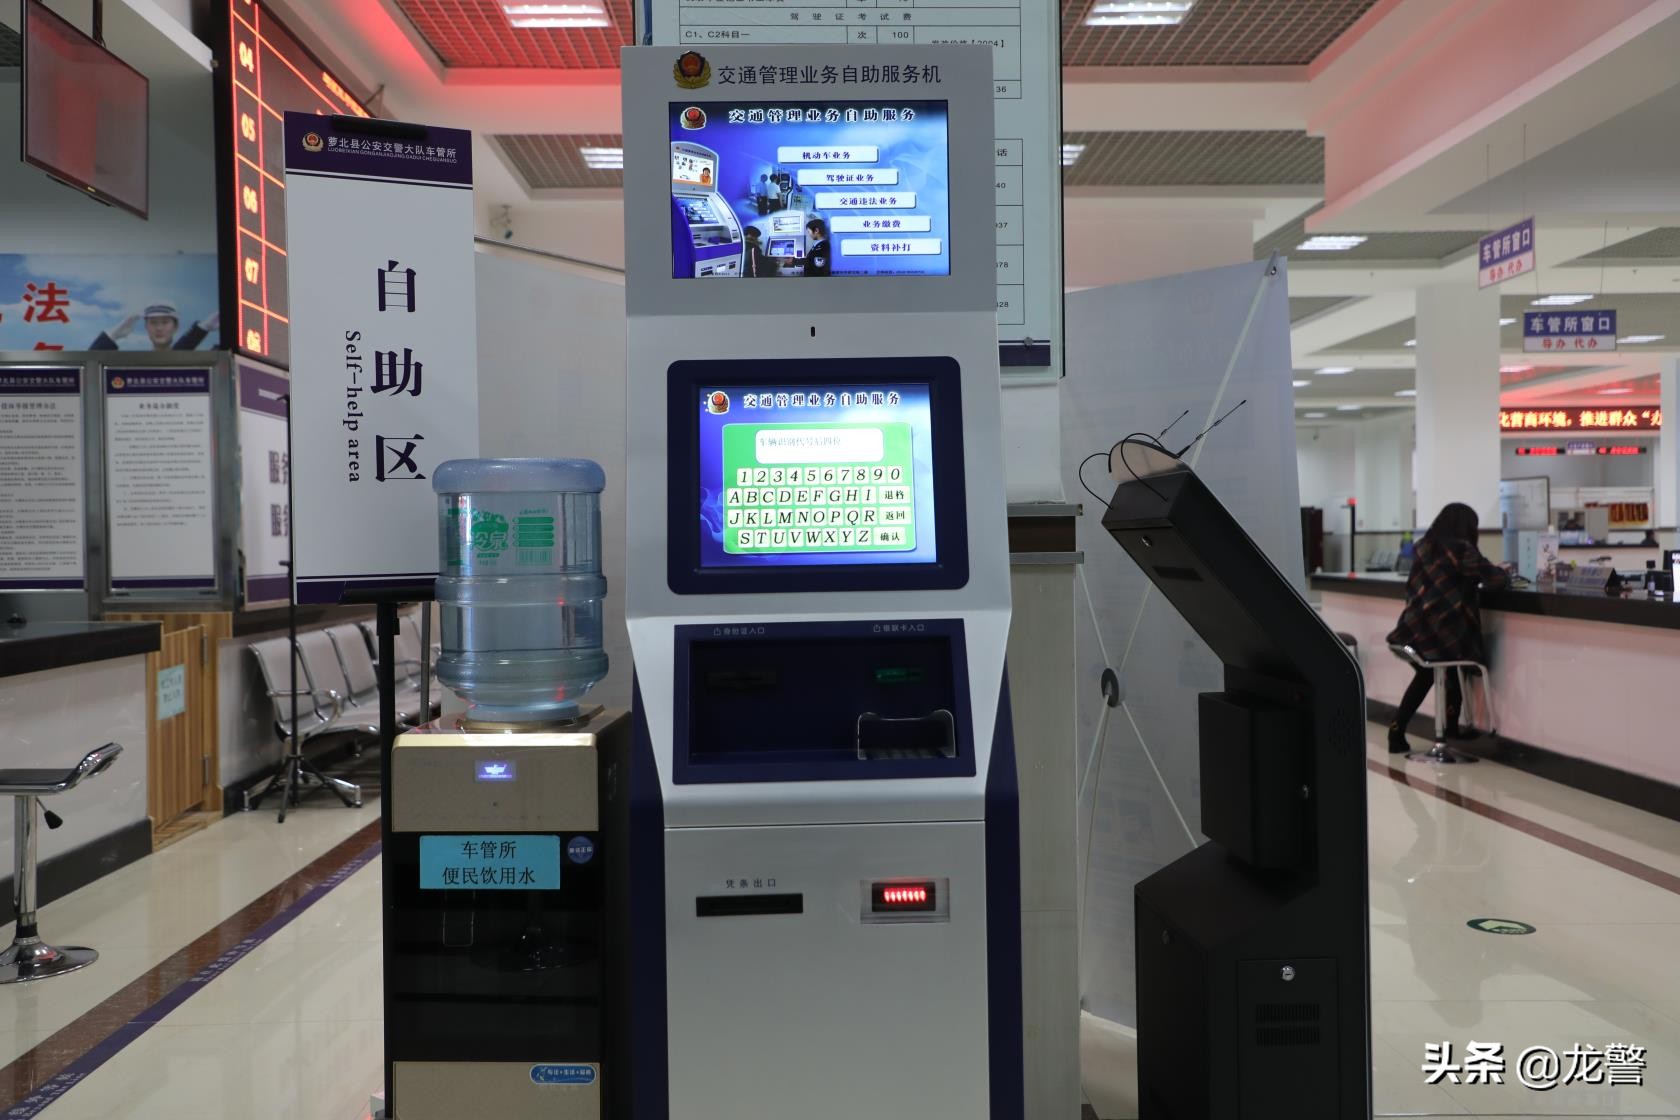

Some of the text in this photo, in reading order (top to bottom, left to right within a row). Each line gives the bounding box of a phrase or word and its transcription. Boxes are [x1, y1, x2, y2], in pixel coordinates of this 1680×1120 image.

[685, 30, 750, 39] C1、C2科目一
[857, 31, 867, 39] 次
[892, 31, 909, 39] 100
[717, 64, 942, 85] 交通管理业务自助服务机
[728, 107, 917, 124] 交通管理业务自助服务
[241, 112, 256, 142] 05
[327, 135, 458, 159] 萝北县公安交警大队车管所
[802, 151, 851, 160] 机动车业务
[826, 174, 875, 183] 驾驶证业务
[839, 197, 898, 206] 交通违法业务
[862, 219, 901, 229] 业务缴费
[870, 243, 912, 252] 资料补打
[1482, 228, 1531, 263] 车管所窗口
[244, 257, 259, 285] 07
[22, 282, 71, 324] 法
[1530, 316, 1610, 333] 车管所窗口
[370, 259, 427, 483] 自助区
[342, 330, 364, 483] Self-help area
[743, 391, 901, 408] 交通管理业务自助服务
[741, 468, 900, 482] 1 2 3 4 5 6 7 8 9 0
[729, 489, 872, 504] A B C D E F G H I
[729, 510, 875, 525] J K L M N O P Q R
[740, 530, 869, 545] S T U V W X Y Z
[460, 840, 518, 860] 车管所
[441, 866, 537, 886] 便民饮用水
[725, 878, 777, 889] 凭条出口
